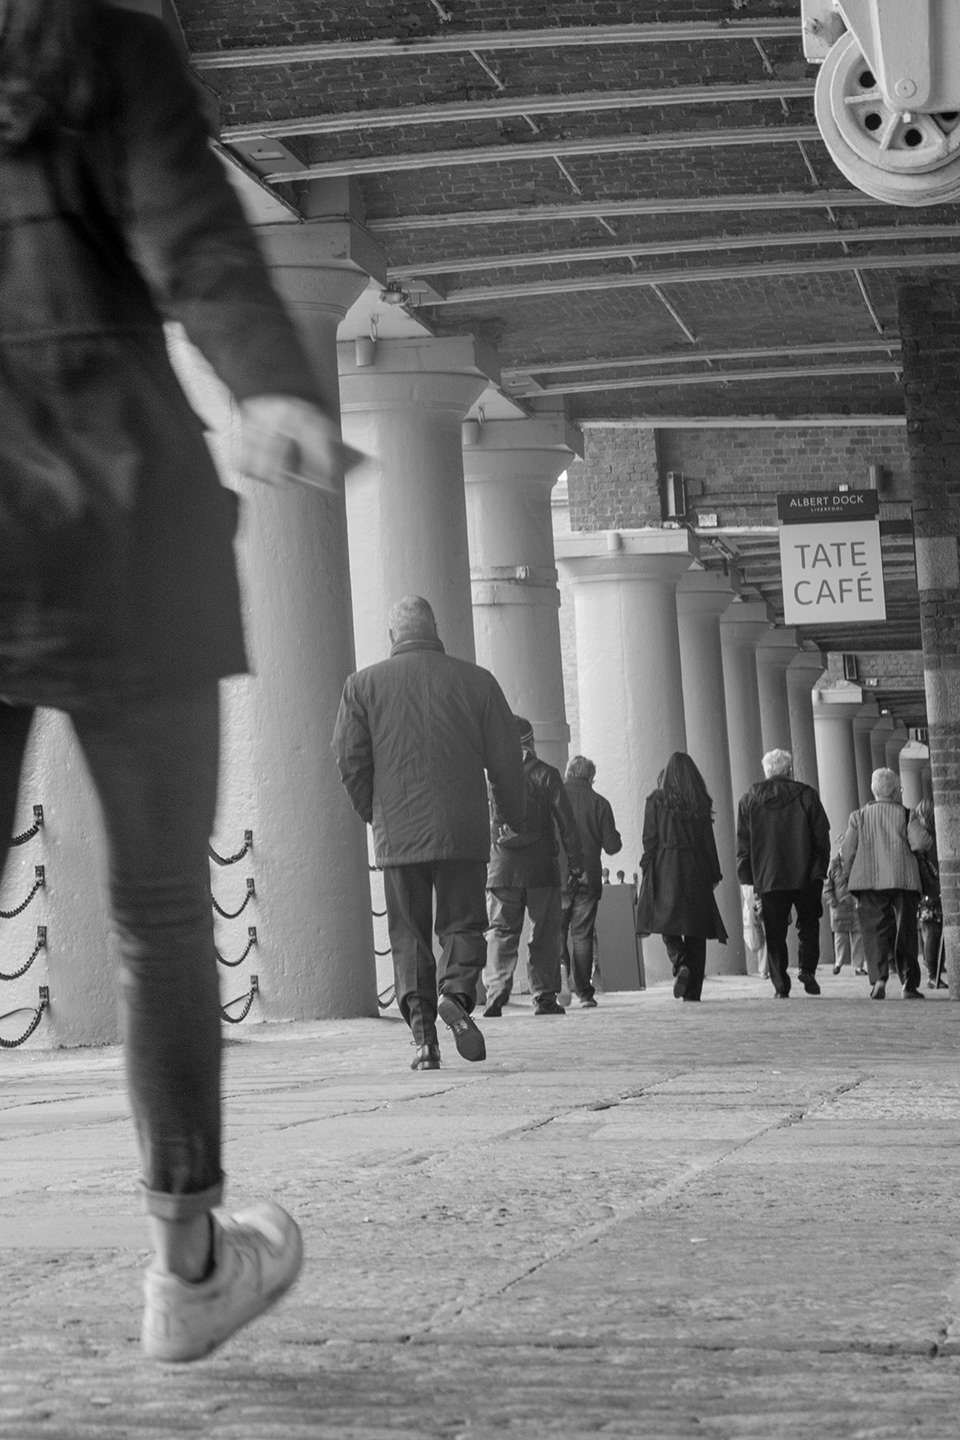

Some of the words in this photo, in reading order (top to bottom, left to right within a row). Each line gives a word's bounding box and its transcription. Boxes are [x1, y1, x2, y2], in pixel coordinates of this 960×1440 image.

[790, 496, 829, 508] ALBERT
[833, 494, 864, 505] DOCK
[794, 541, 867, 569] TATE
[794, 571, 874, 606] CAFÉ
